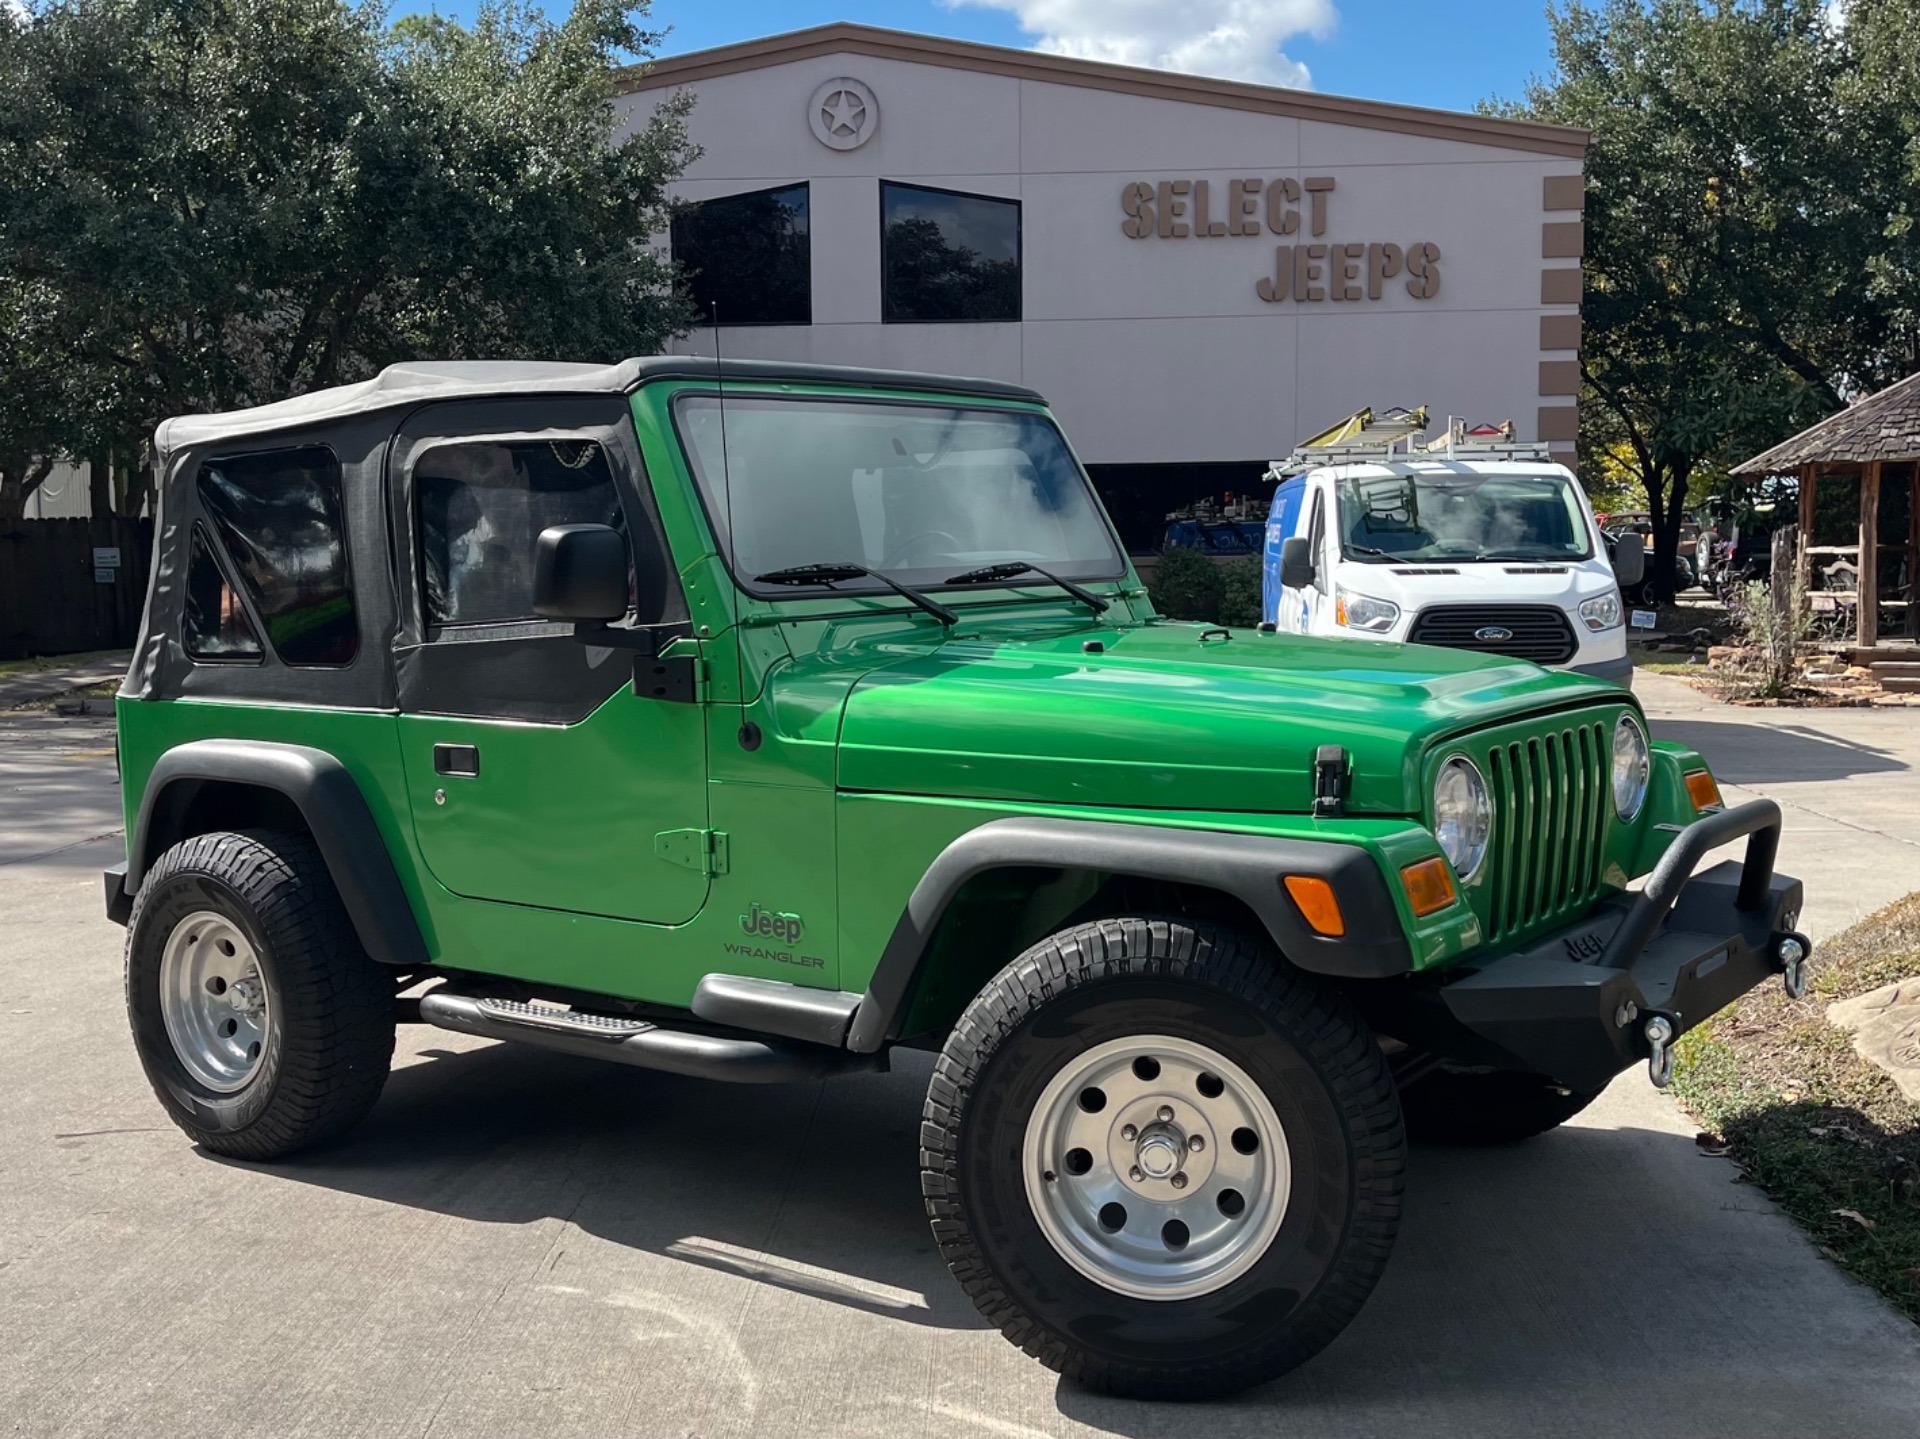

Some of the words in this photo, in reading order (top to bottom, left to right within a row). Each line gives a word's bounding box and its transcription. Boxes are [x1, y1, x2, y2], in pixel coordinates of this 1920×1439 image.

[1121, 177, 1336, 239] SELECT
[1256, 242, 1441, 302] JEEPS
[741, 906, 802, 944] Jeep
[724, 943, 825, 969] WRANGLER
